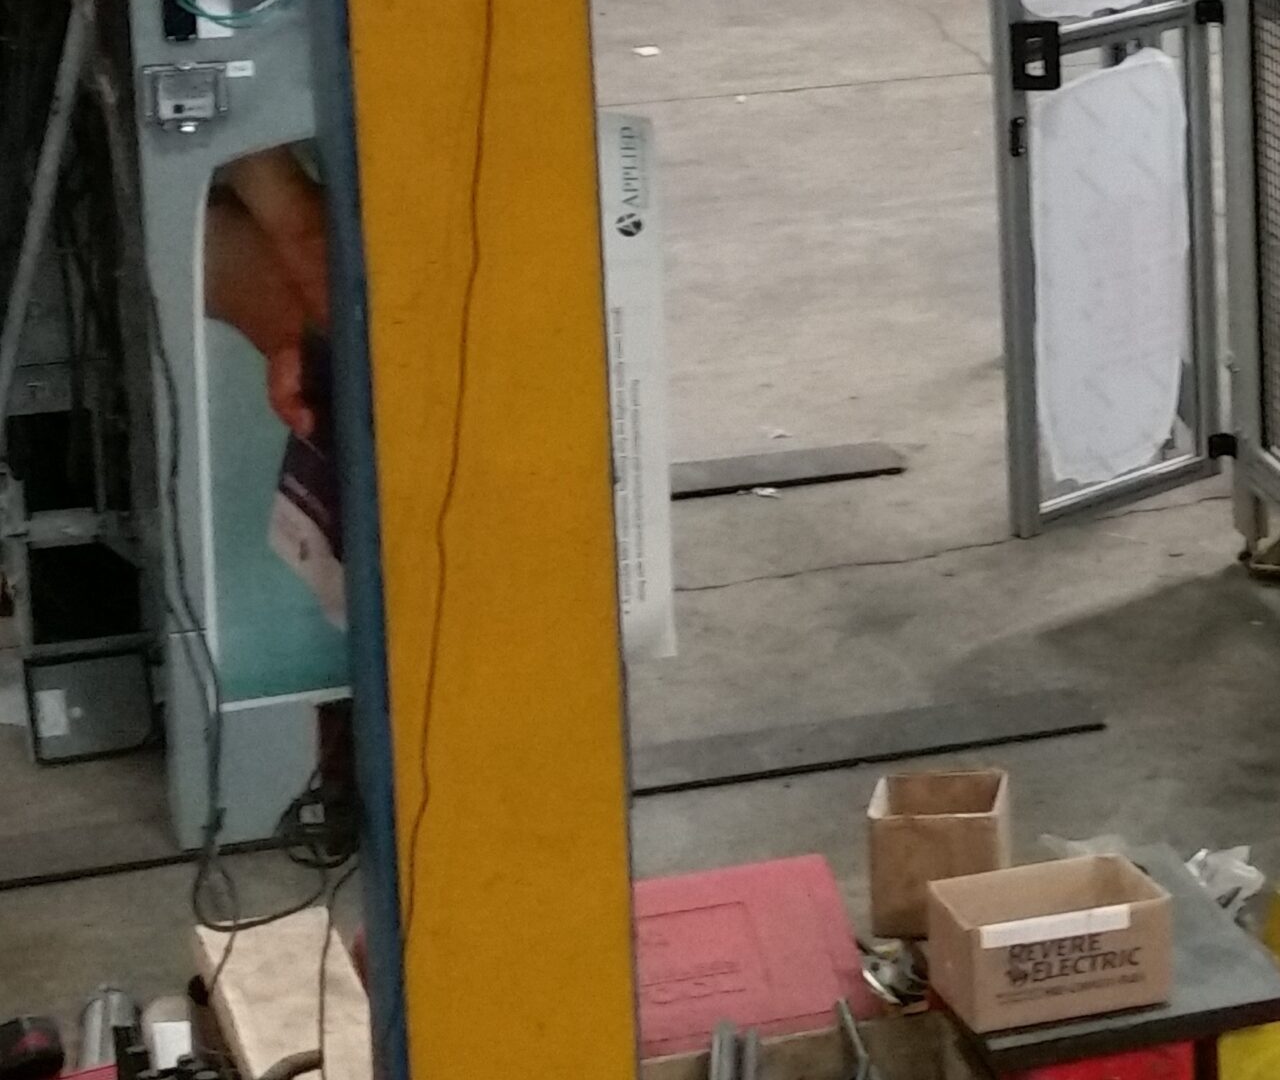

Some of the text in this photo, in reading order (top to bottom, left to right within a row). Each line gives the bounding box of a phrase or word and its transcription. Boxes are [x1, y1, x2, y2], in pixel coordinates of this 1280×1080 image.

[620, 125, 640, 208] APPLIED
[1009, 933, 1102, 962] REVERE
[1032, 947, 1142, 982] ELECTRIC
